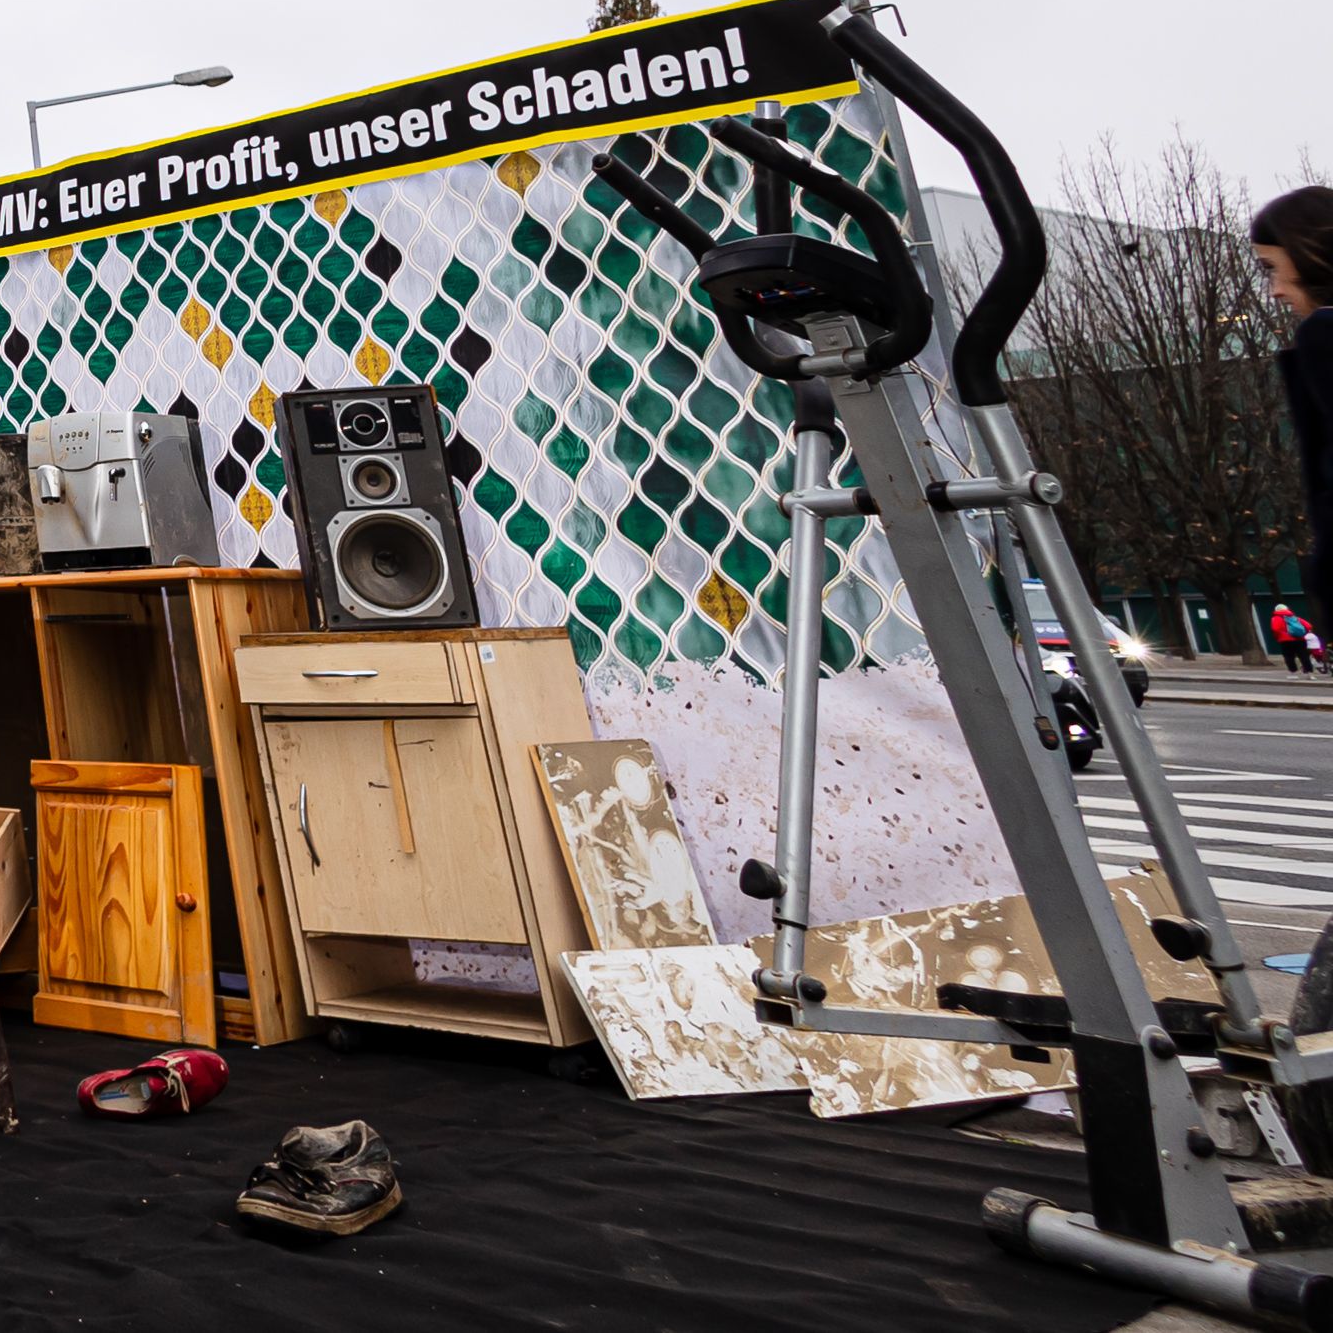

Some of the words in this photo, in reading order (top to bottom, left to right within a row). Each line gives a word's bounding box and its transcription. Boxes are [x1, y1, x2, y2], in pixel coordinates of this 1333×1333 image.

[59, 169, 147, 224] Euer
[158, 134, 300, 201] Profit,
[308, 99, 454, 168] unser
[466, 27, 750, 131] Schaden!
